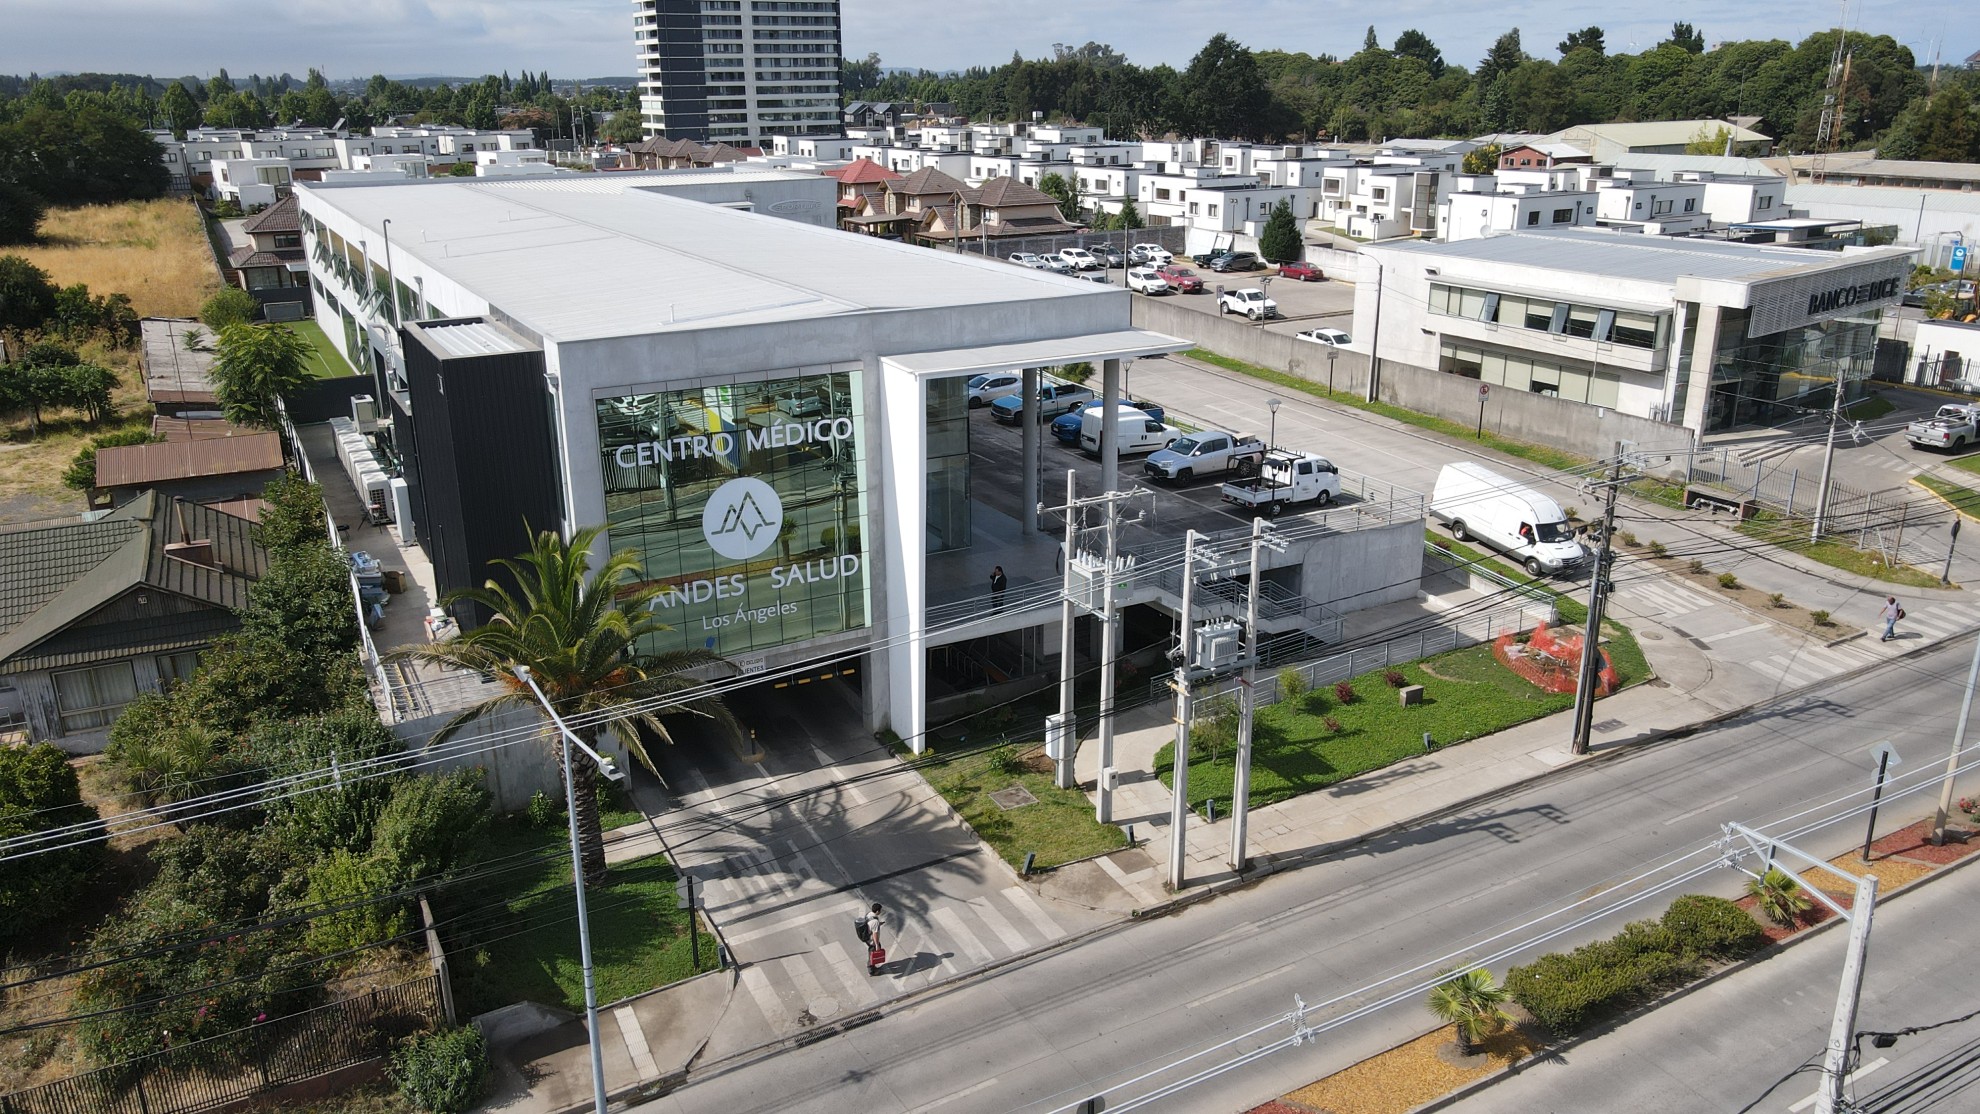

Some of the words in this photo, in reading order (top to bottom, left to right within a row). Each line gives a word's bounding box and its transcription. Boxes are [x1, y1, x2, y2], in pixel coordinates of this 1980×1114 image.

[1808, 286, 1858, 316] BANCO
[1868, 277, 1901, 302] BICE
[615, 432, 734, 468] CENTRO
[746, 417, 853, 452] MÉDICO
[648, 574, 745, 611] ANDES
[770, 554, 859, 589] SALUD
[1618, 579, 1714, 618] PARE
[702, 613, 730, 630] Los
[734, 599, 798, 624] Ángeles
